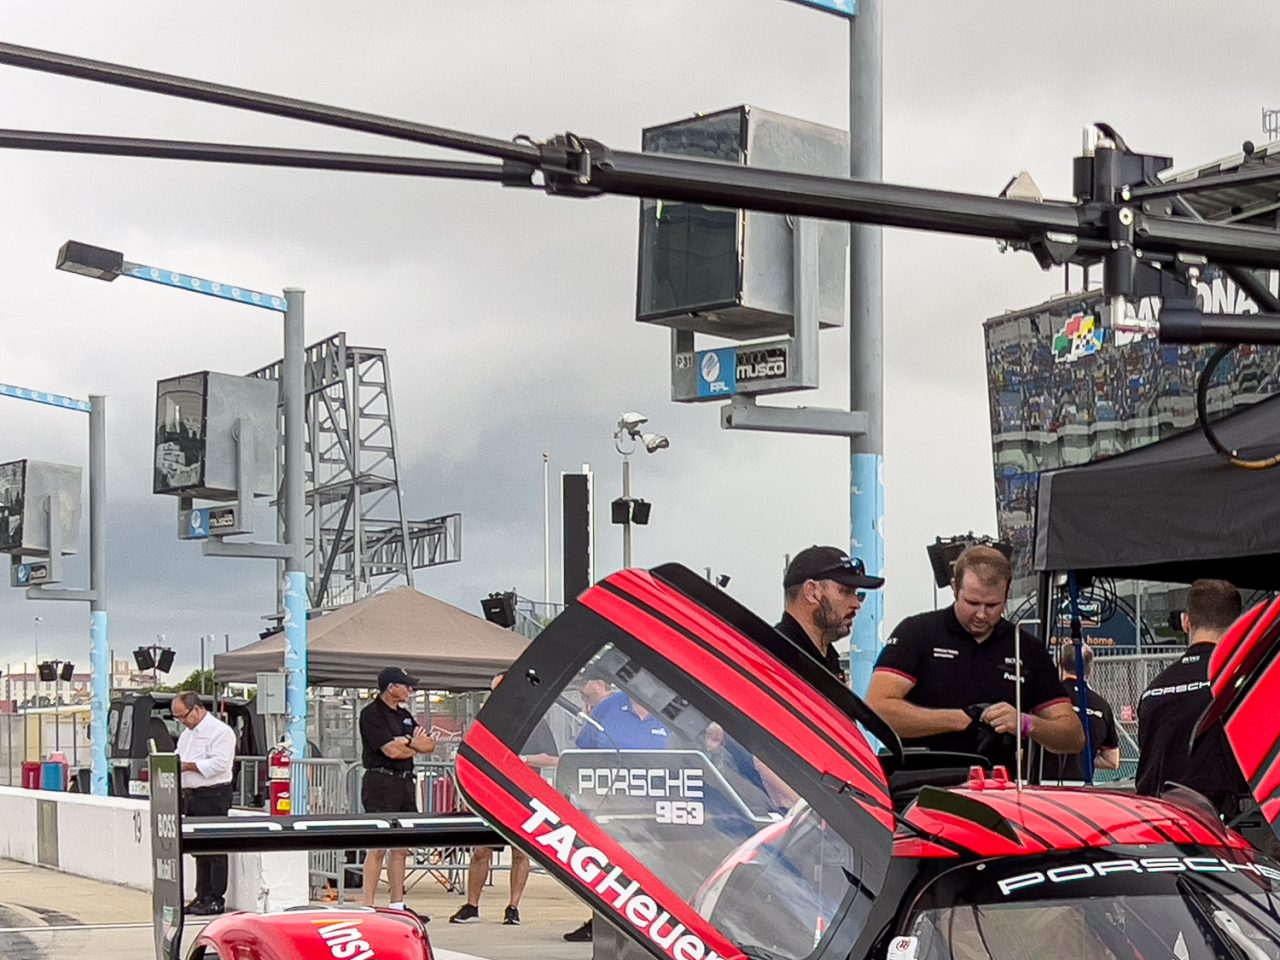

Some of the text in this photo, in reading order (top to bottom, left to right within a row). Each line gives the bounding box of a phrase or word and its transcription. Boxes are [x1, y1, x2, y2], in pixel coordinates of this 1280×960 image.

[578, 768, 704, 798] PORSCHE
[655, 801, 704, 825] 963
[157, 814, 176, 838] BOSS
